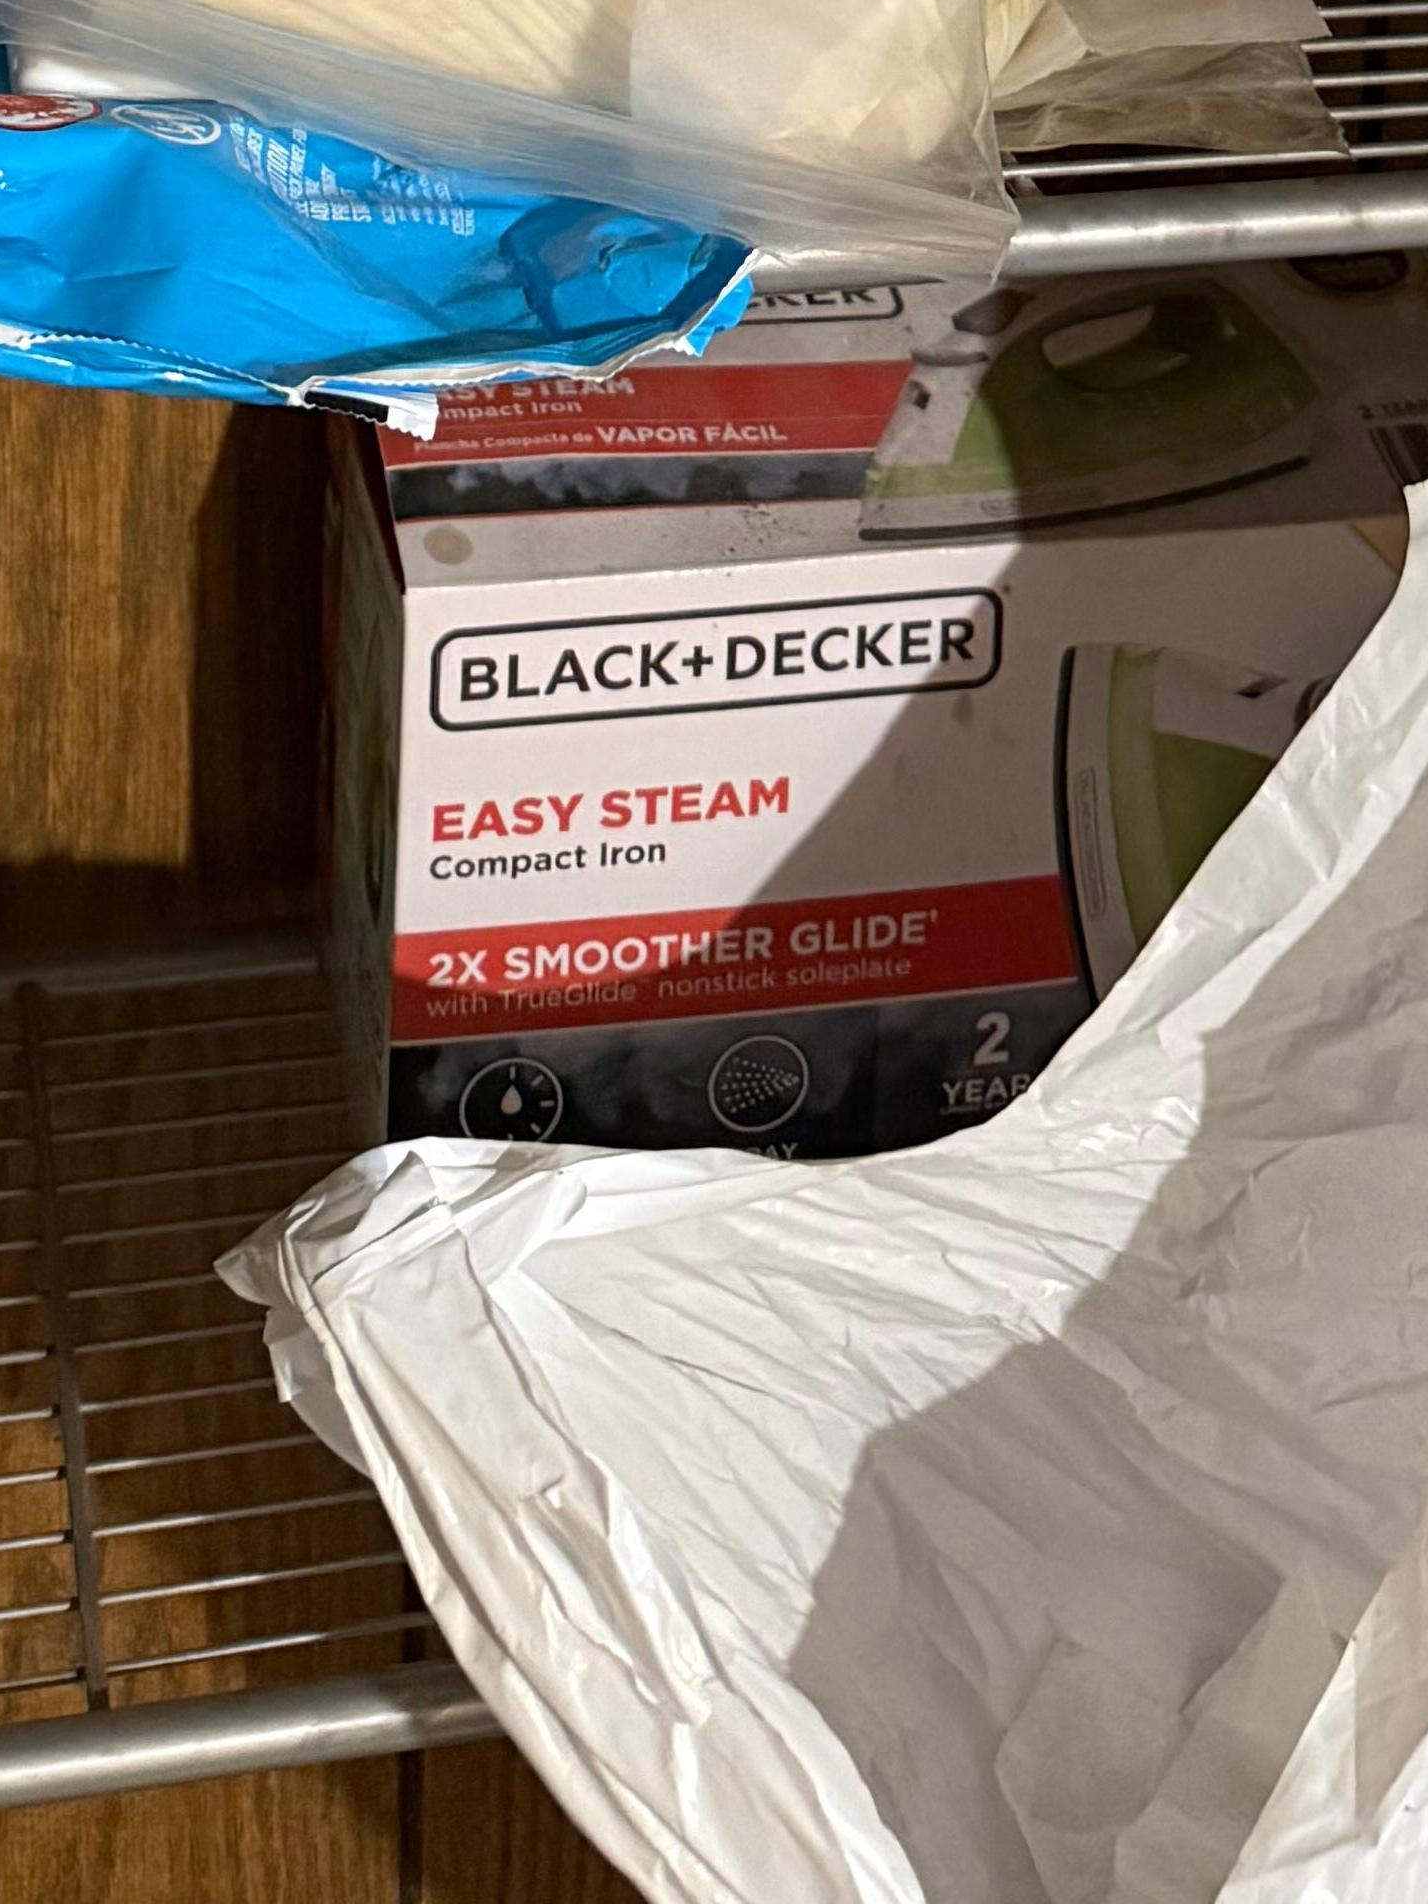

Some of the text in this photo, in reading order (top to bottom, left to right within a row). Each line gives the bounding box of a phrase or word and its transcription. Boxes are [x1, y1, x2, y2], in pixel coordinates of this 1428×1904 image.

[439, 399, 583, 422] mpact Iron
[513, 376, 636, 398] STEAM
[483, 431, 570, 449] Compacta
[572, 431, 593, 443] de
[595, 425, 698, 444] VAPOR
[703, 421, 788, 443] FÁCIL
[460, 617, 974, 702] BLACK+DECKER
[431, 776, 790, 843] EASY STEAM
[429, 839, 666, 880] Compact Iron
[428, 949, 488, 988] 2X
[503, 926, 773, 981] SMOOTHER
[426, 992, 488, 1020] with
[658, 965, 775, 998] nonstick
[785, 957, 912, 993] soleplate
[974, 1011, 1011, 1066] 2
